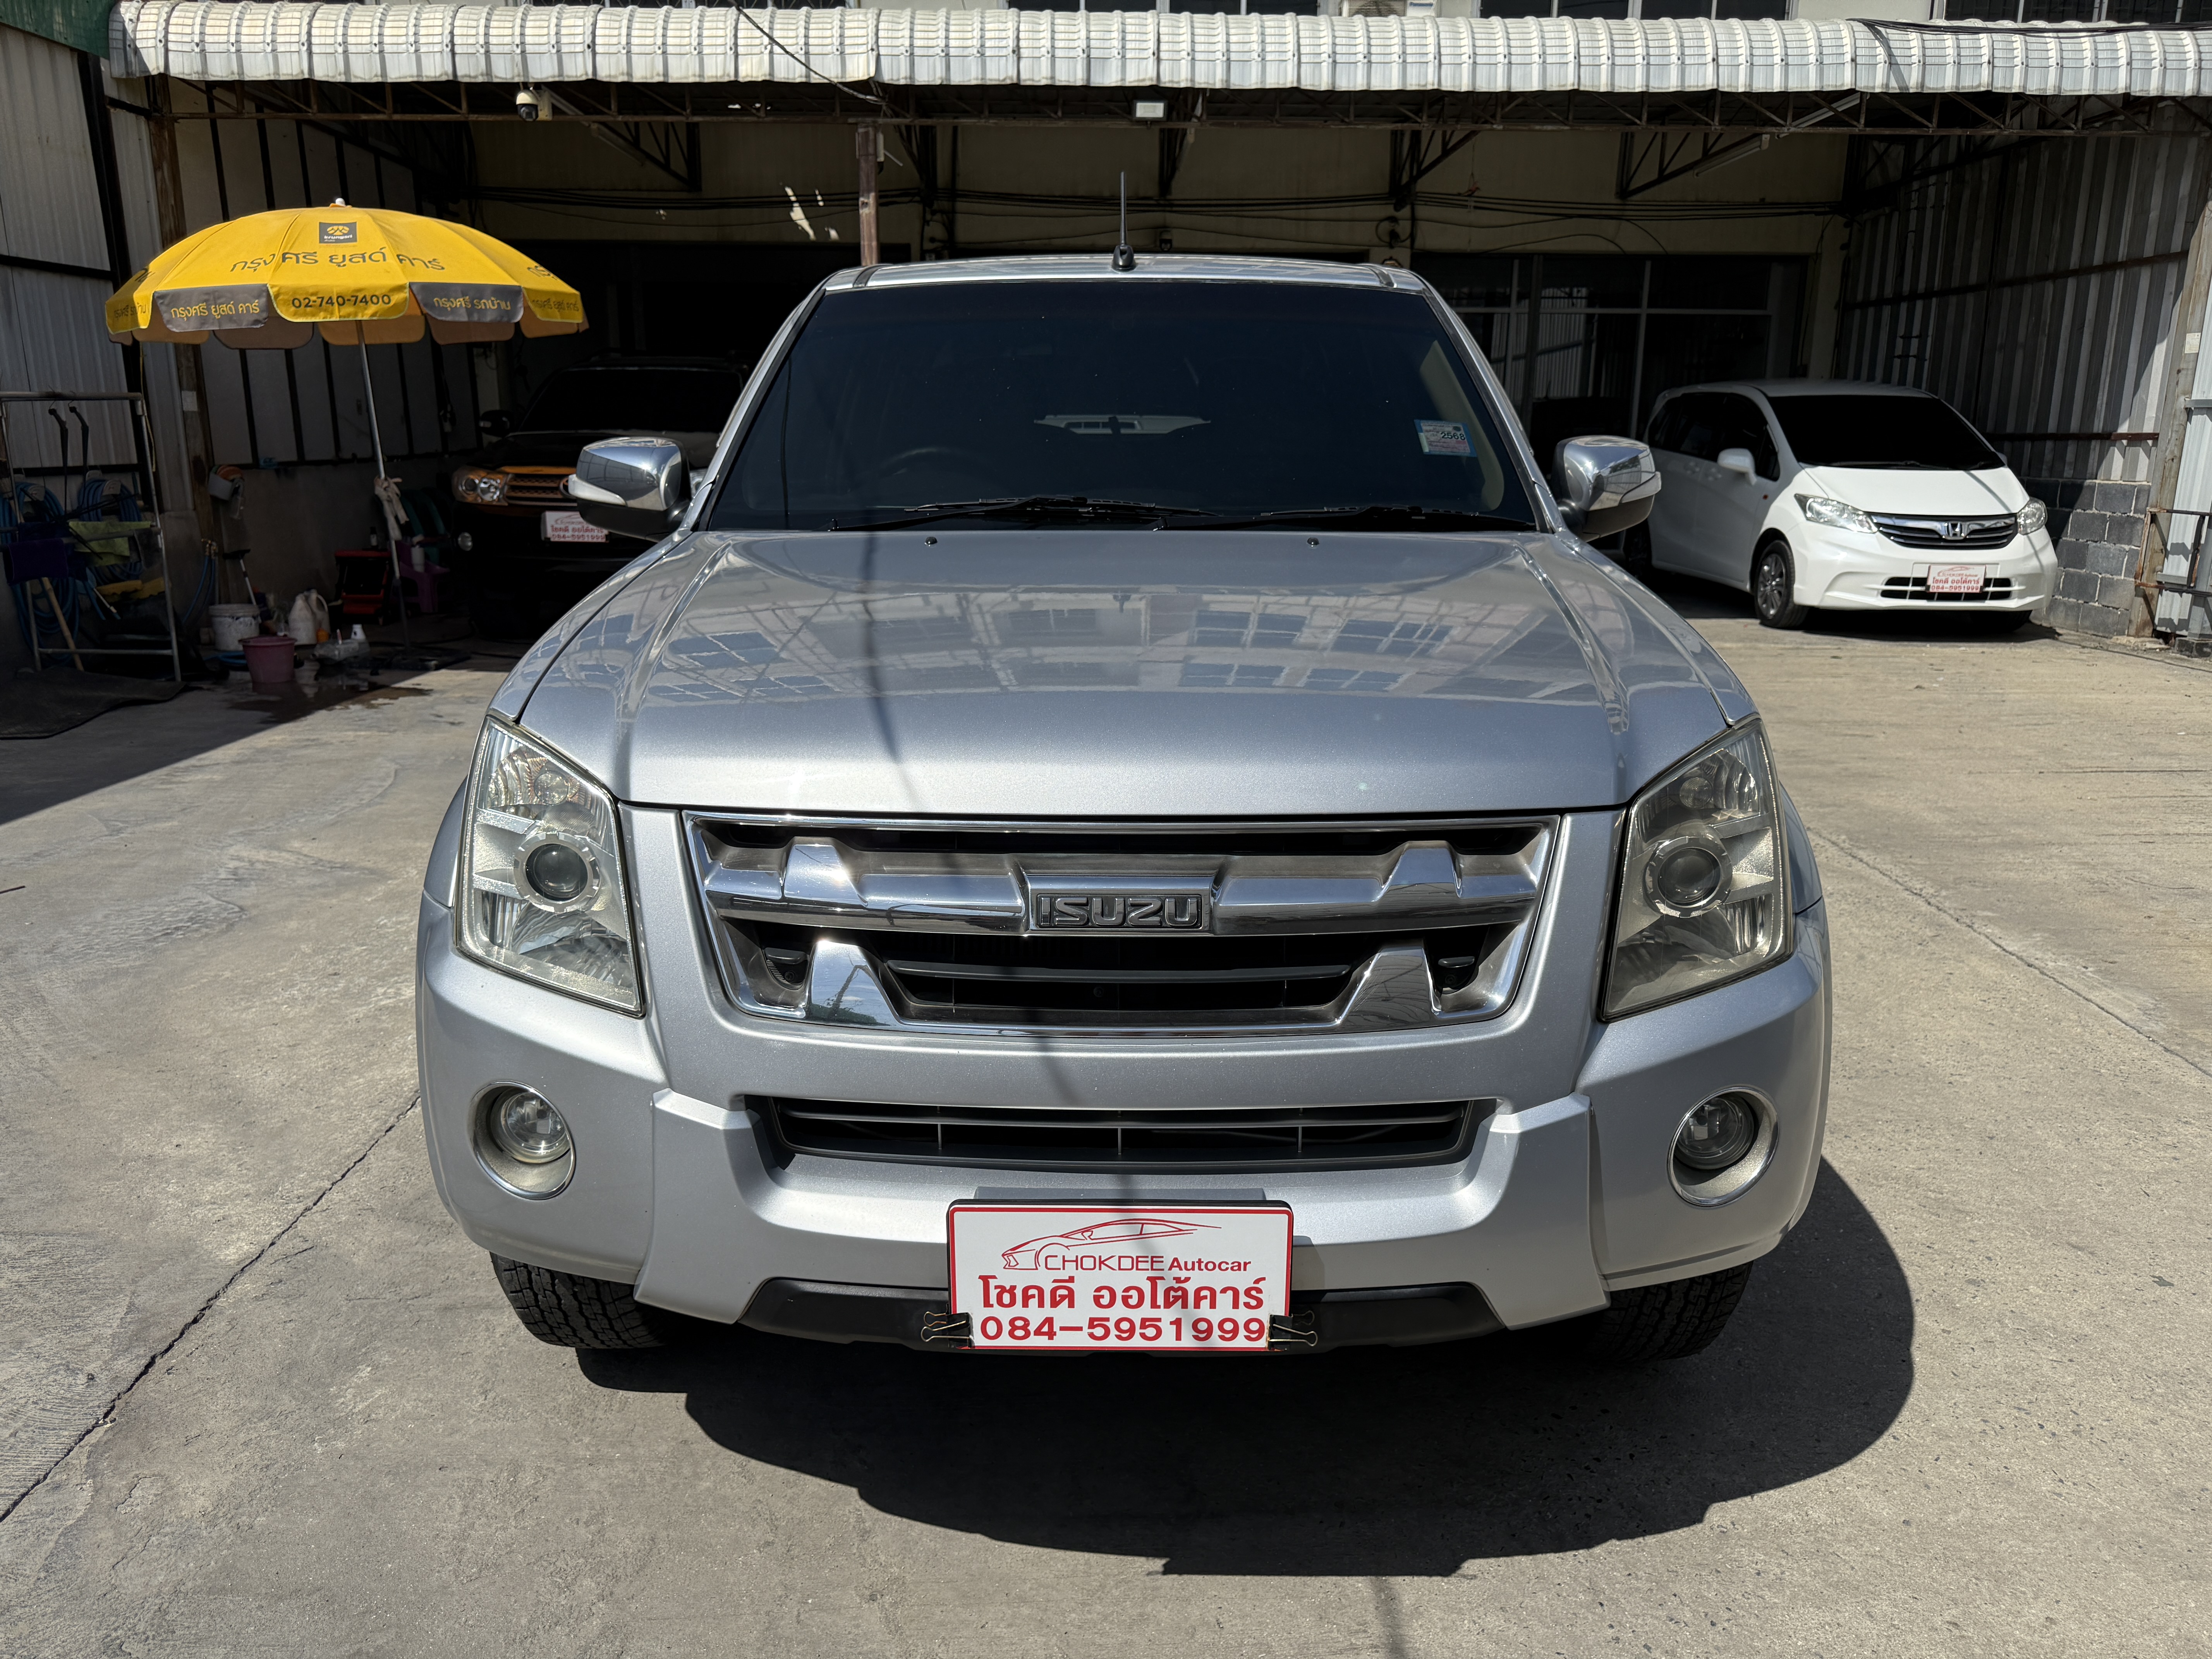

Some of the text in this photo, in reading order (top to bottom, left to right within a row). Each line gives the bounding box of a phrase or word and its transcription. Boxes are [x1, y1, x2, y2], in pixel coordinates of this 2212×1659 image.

[328, 247, 386, 267] ยูสด์
[396, 254, 445, 270] คาร์
[171, 299, 260, 321] กรุงศรี ยูสด์ คาร์
[292, 294, 392, 309] 02-740-7400
[433, 296, 472, 311] กรุงศรี
[1440, 432, 1466, 441] 2568
[1041, 897, 1198, 926] ISUZU
[1044, 1255, 1251, 1272] CHOKDEE Autocar
[978, 1275, 1266, 1310] โชคดี ออโต้คาร์
[980, 1316, 1266, 1341] 084-5951999
